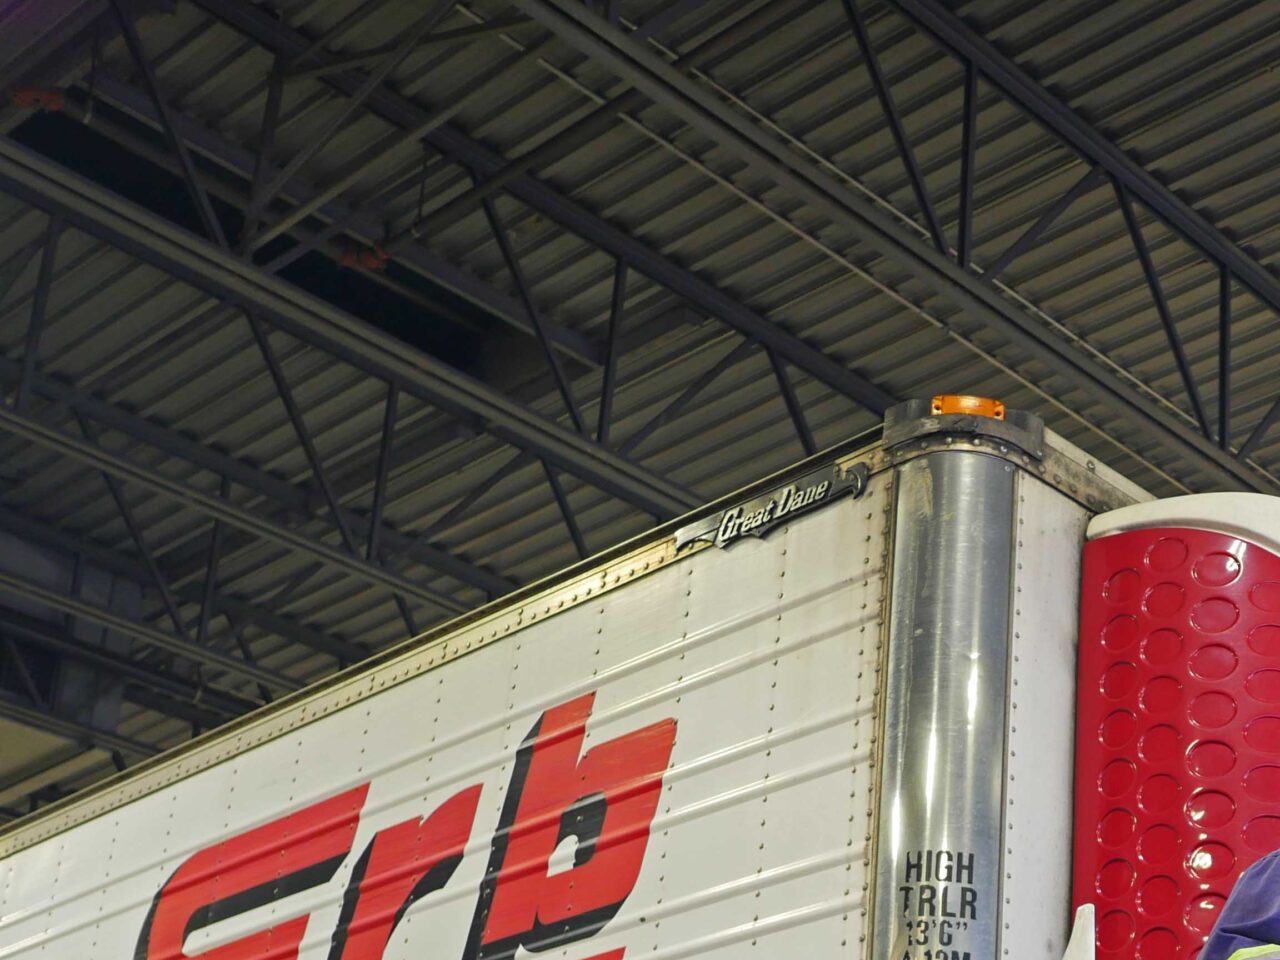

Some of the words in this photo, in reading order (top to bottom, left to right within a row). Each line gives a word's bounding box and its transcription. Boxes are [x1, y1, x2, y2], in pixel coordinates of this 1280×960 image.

[718, 501, 775, 541] Great
[774, 480, 829, 518] Dane
[905, 850, 975, 885] HIGH
[899, 884, 978, 920] TRLR
